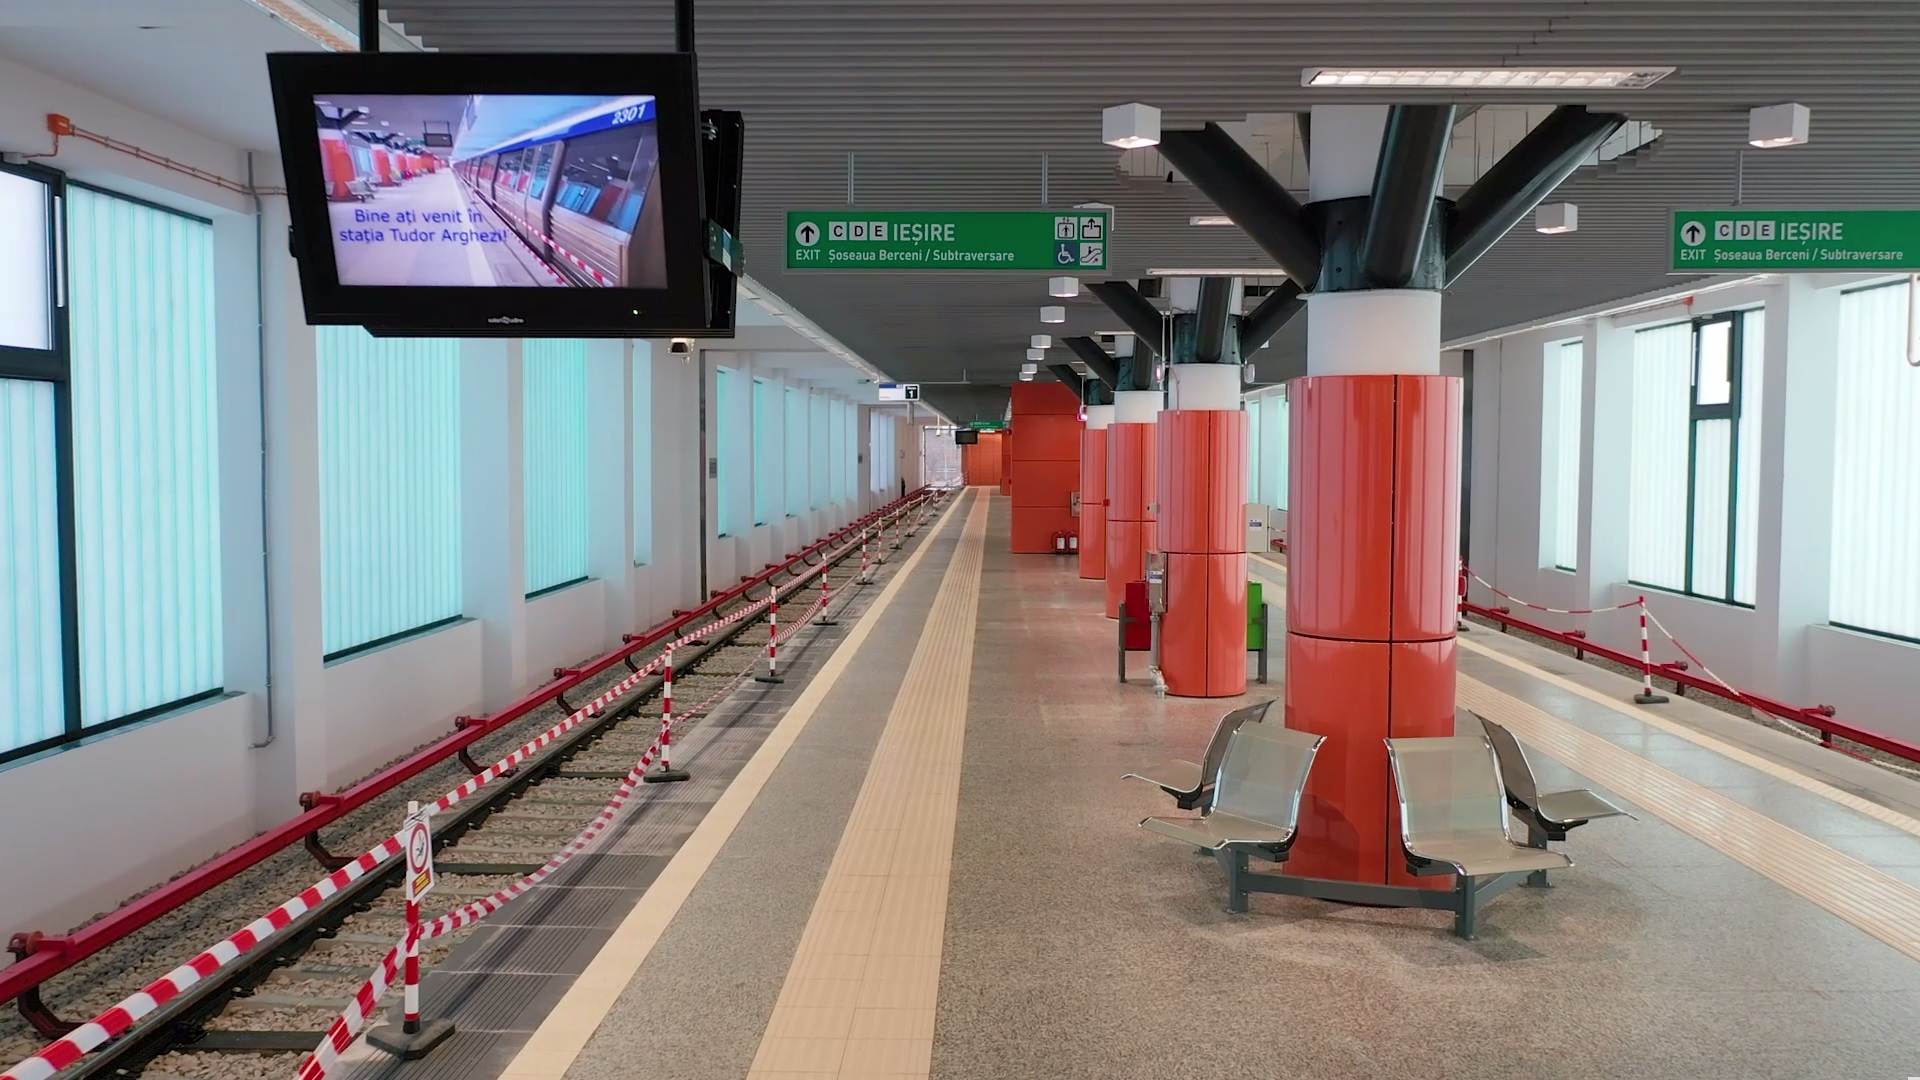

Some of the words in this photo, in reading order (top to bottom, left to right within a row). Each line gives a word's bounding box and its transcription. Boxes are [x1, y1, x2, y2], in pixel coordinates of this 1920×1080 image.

[611, 103, 646, 125] 2301
[354, 209, 390, 223] Bine
[422, 210, 462, 224] venit
[468, 208, 482, 223] în
[389, 228, 436, 242] Tudor
[441, 229, 507, 245] Arghezi!
[833, 224, 843, 238] C
[854, 225, 864, 237] D
[874, 225, 883, 237] E
[893, 223, 955, 246] IEȘIRE
[1719, 224, 1730, 237] C
[1740, 224, 1751, 237] D
[1761, 224, 1770, 237] E
[1780, 222, 1844, 245] IEȘIRE
[795, 249, 821, 260] EXIT
[828, 249, 876, 263] Șoseaua
[879, 249, 922, 261] Berceni
[933, 250, 1015, 261] Subtraversare
[1680, 249, 1707, 261] EXIT
[1713, 248, 1763, 263] Șoseaua
[1765, 248, 1810, 261] Berceni
[1820, 248, 1904, 260] Subtraversare
[908, 390, 914, 399] 1
